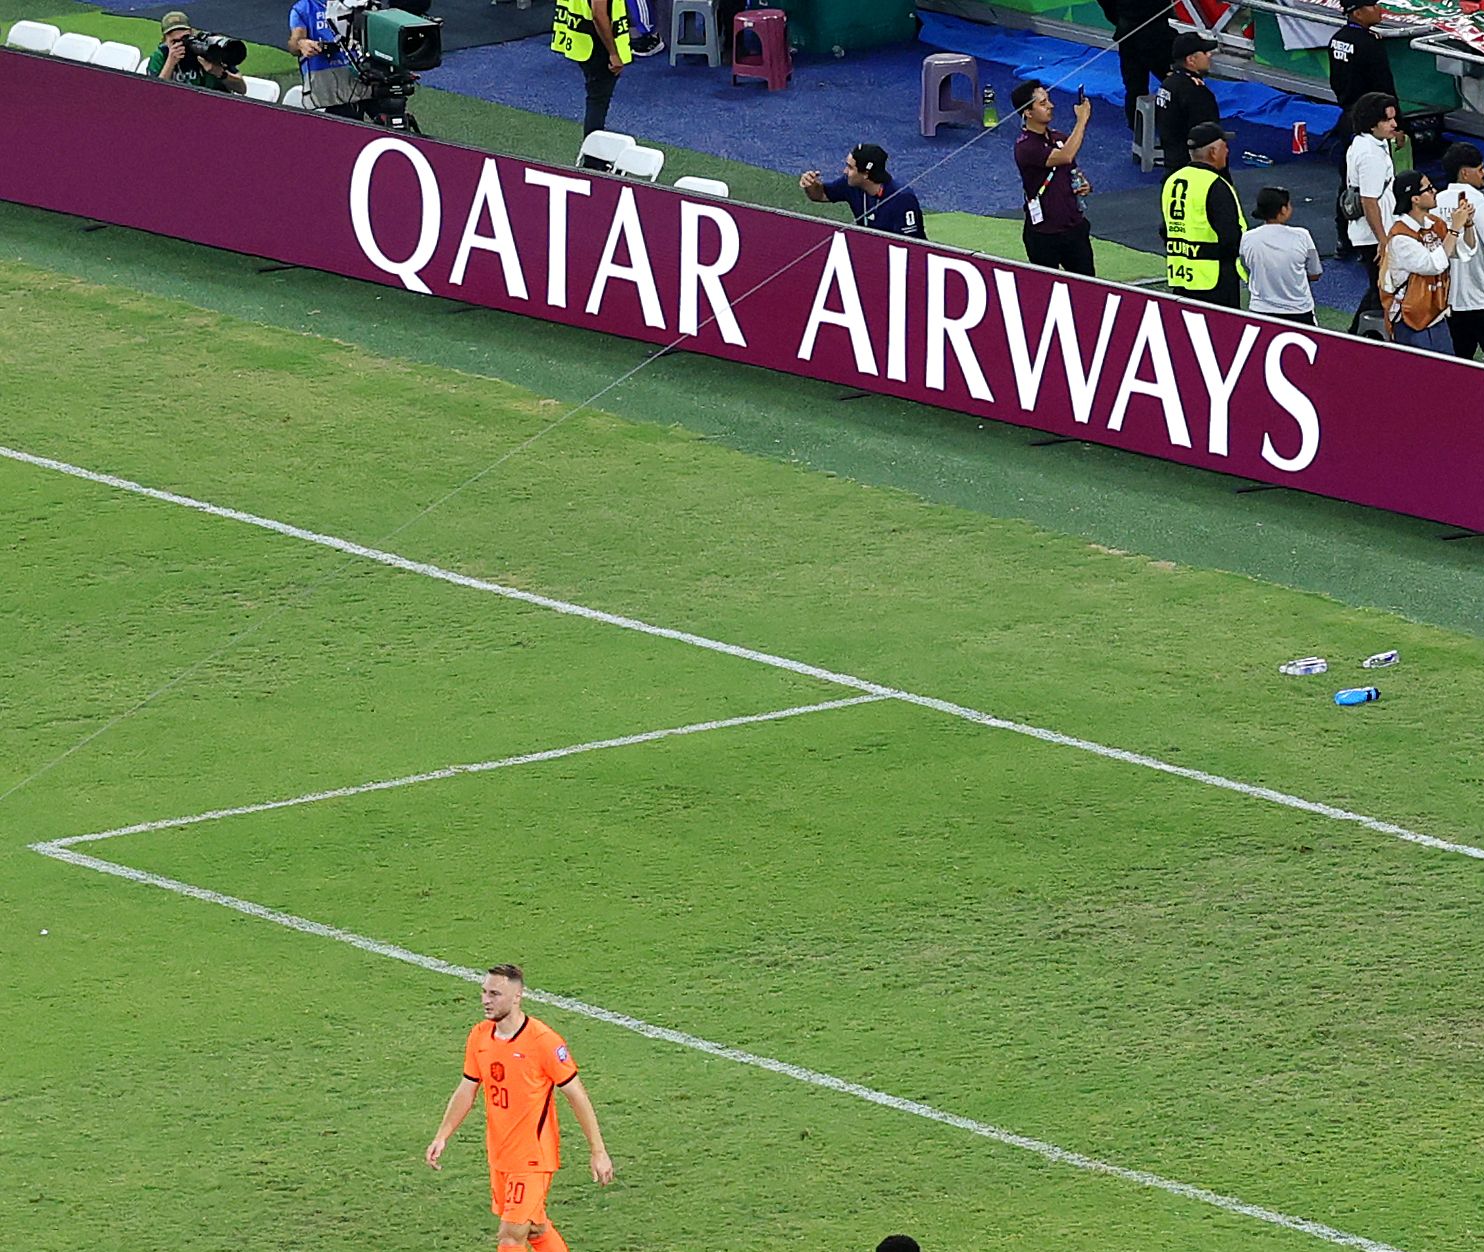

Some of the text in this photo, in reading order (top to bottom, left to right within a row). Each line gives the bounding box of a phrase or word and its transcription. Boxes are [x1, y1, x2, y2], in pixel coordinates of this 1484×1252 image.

[349, 137, 748, 348] QATAR
[797, 231, 1321, 472] AIRWAYS
[490, 1085, 508, 1110] 20
